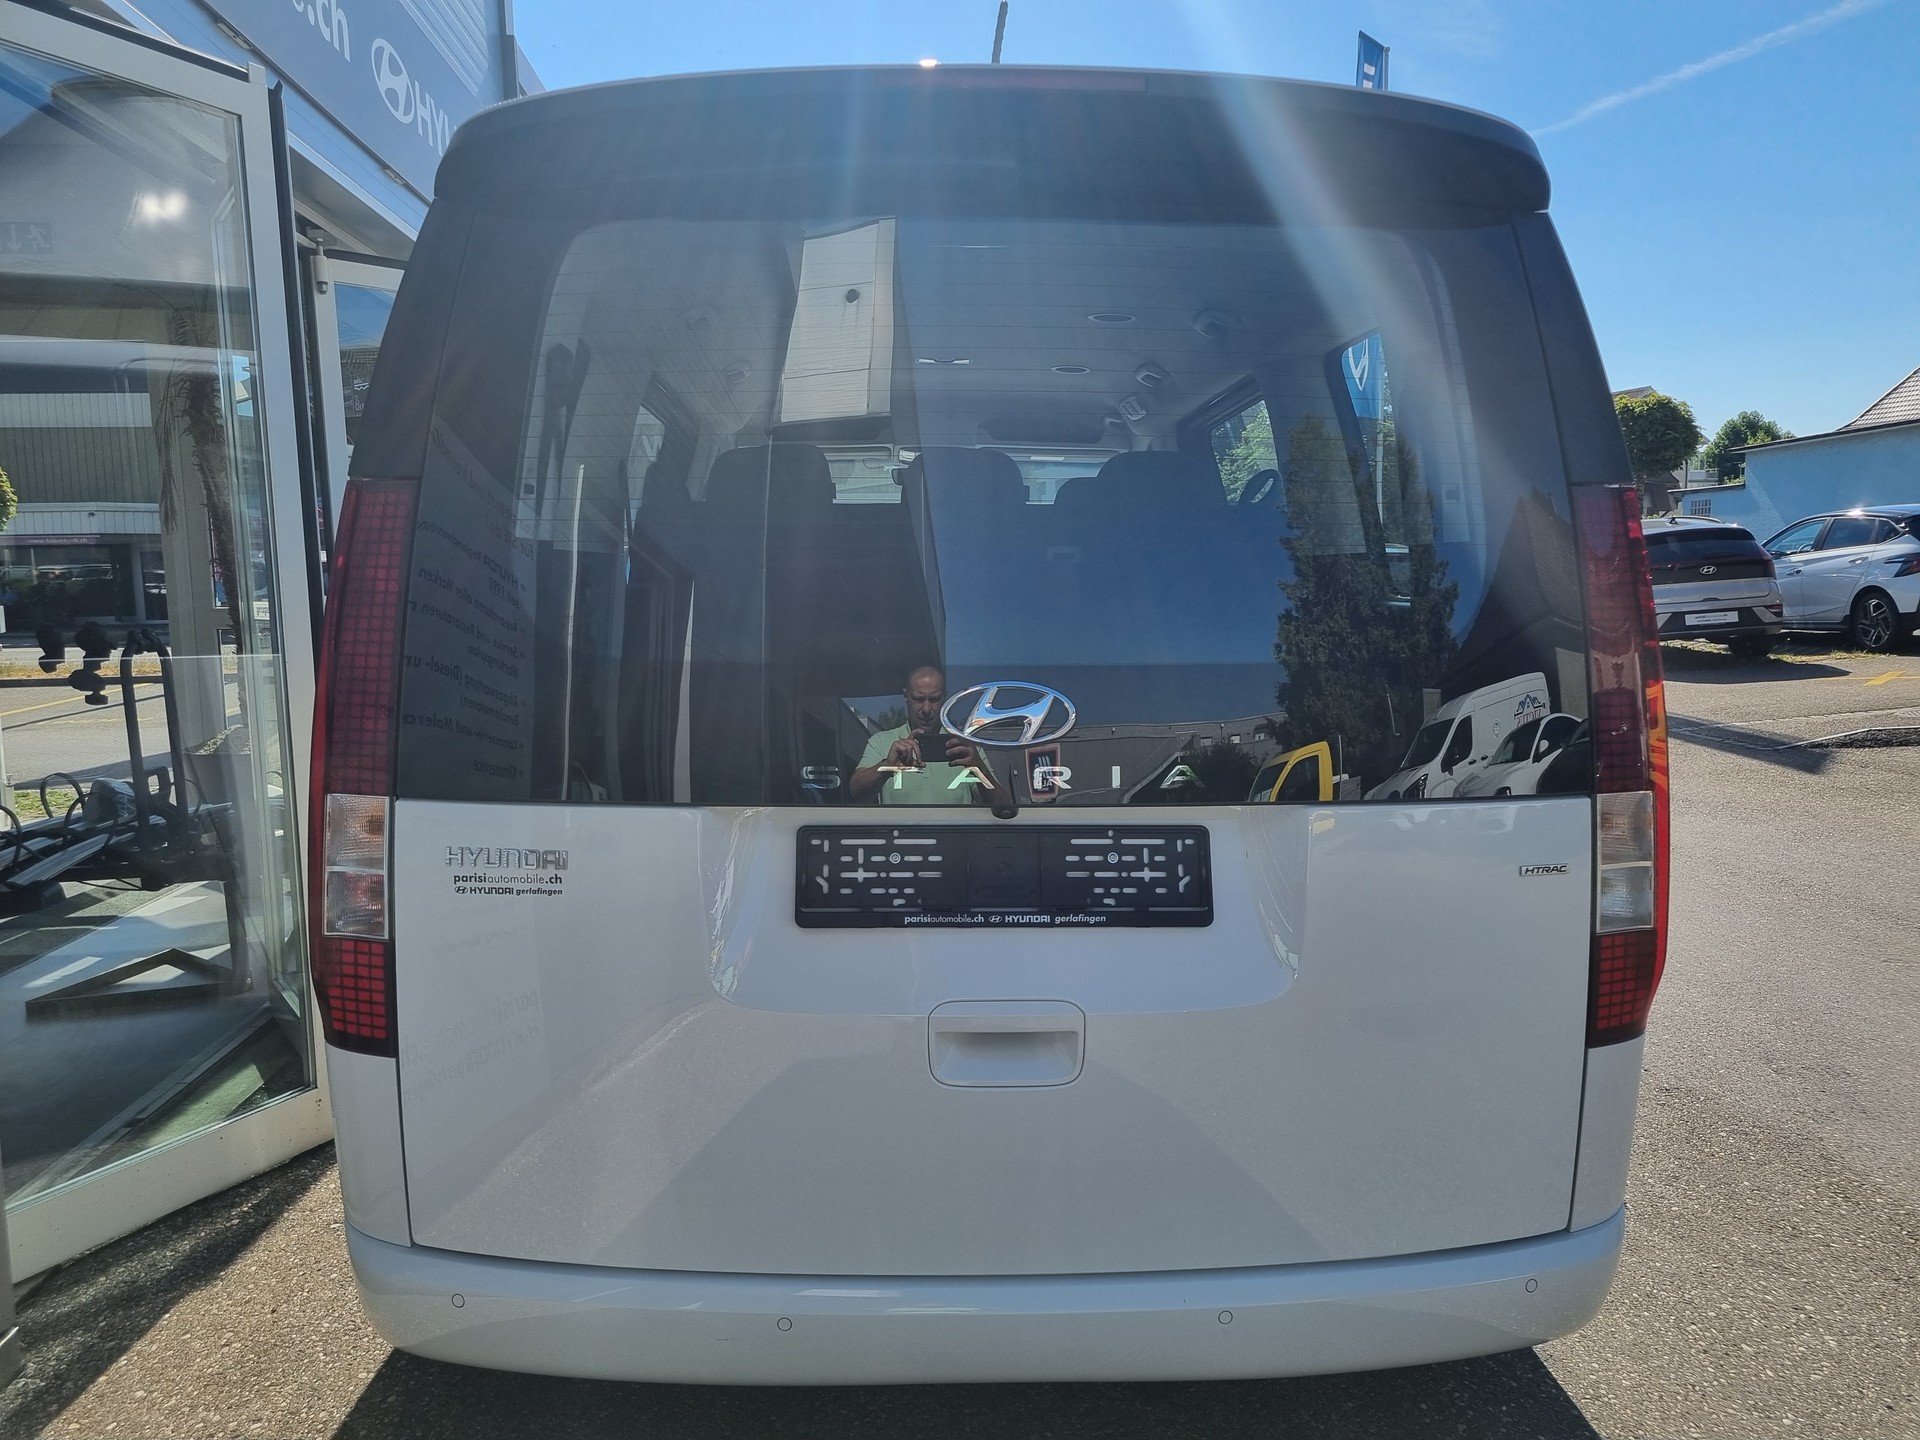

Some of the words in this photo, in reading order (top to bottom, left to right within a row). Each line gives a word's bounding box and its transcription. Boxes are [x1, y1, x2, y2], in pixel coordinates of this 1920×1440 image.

[801, 766, 1208, 790] STARIA
[445, 846, 568, 870] HYUNDAI
[1525, 865, 1568, 875] HTRAC
[453, 872, 562, 884] parisiautomobile.ch
[469, 886, 514, 895] HYUNDAI
[515, 887, 563, 896] gerlafingen
[904, 914, 984, 924] parisiautomobile.ch
[1005, 915, 1050, 923] HYUNDAI
[1054, 914, 1106, 924] gerlafingen
